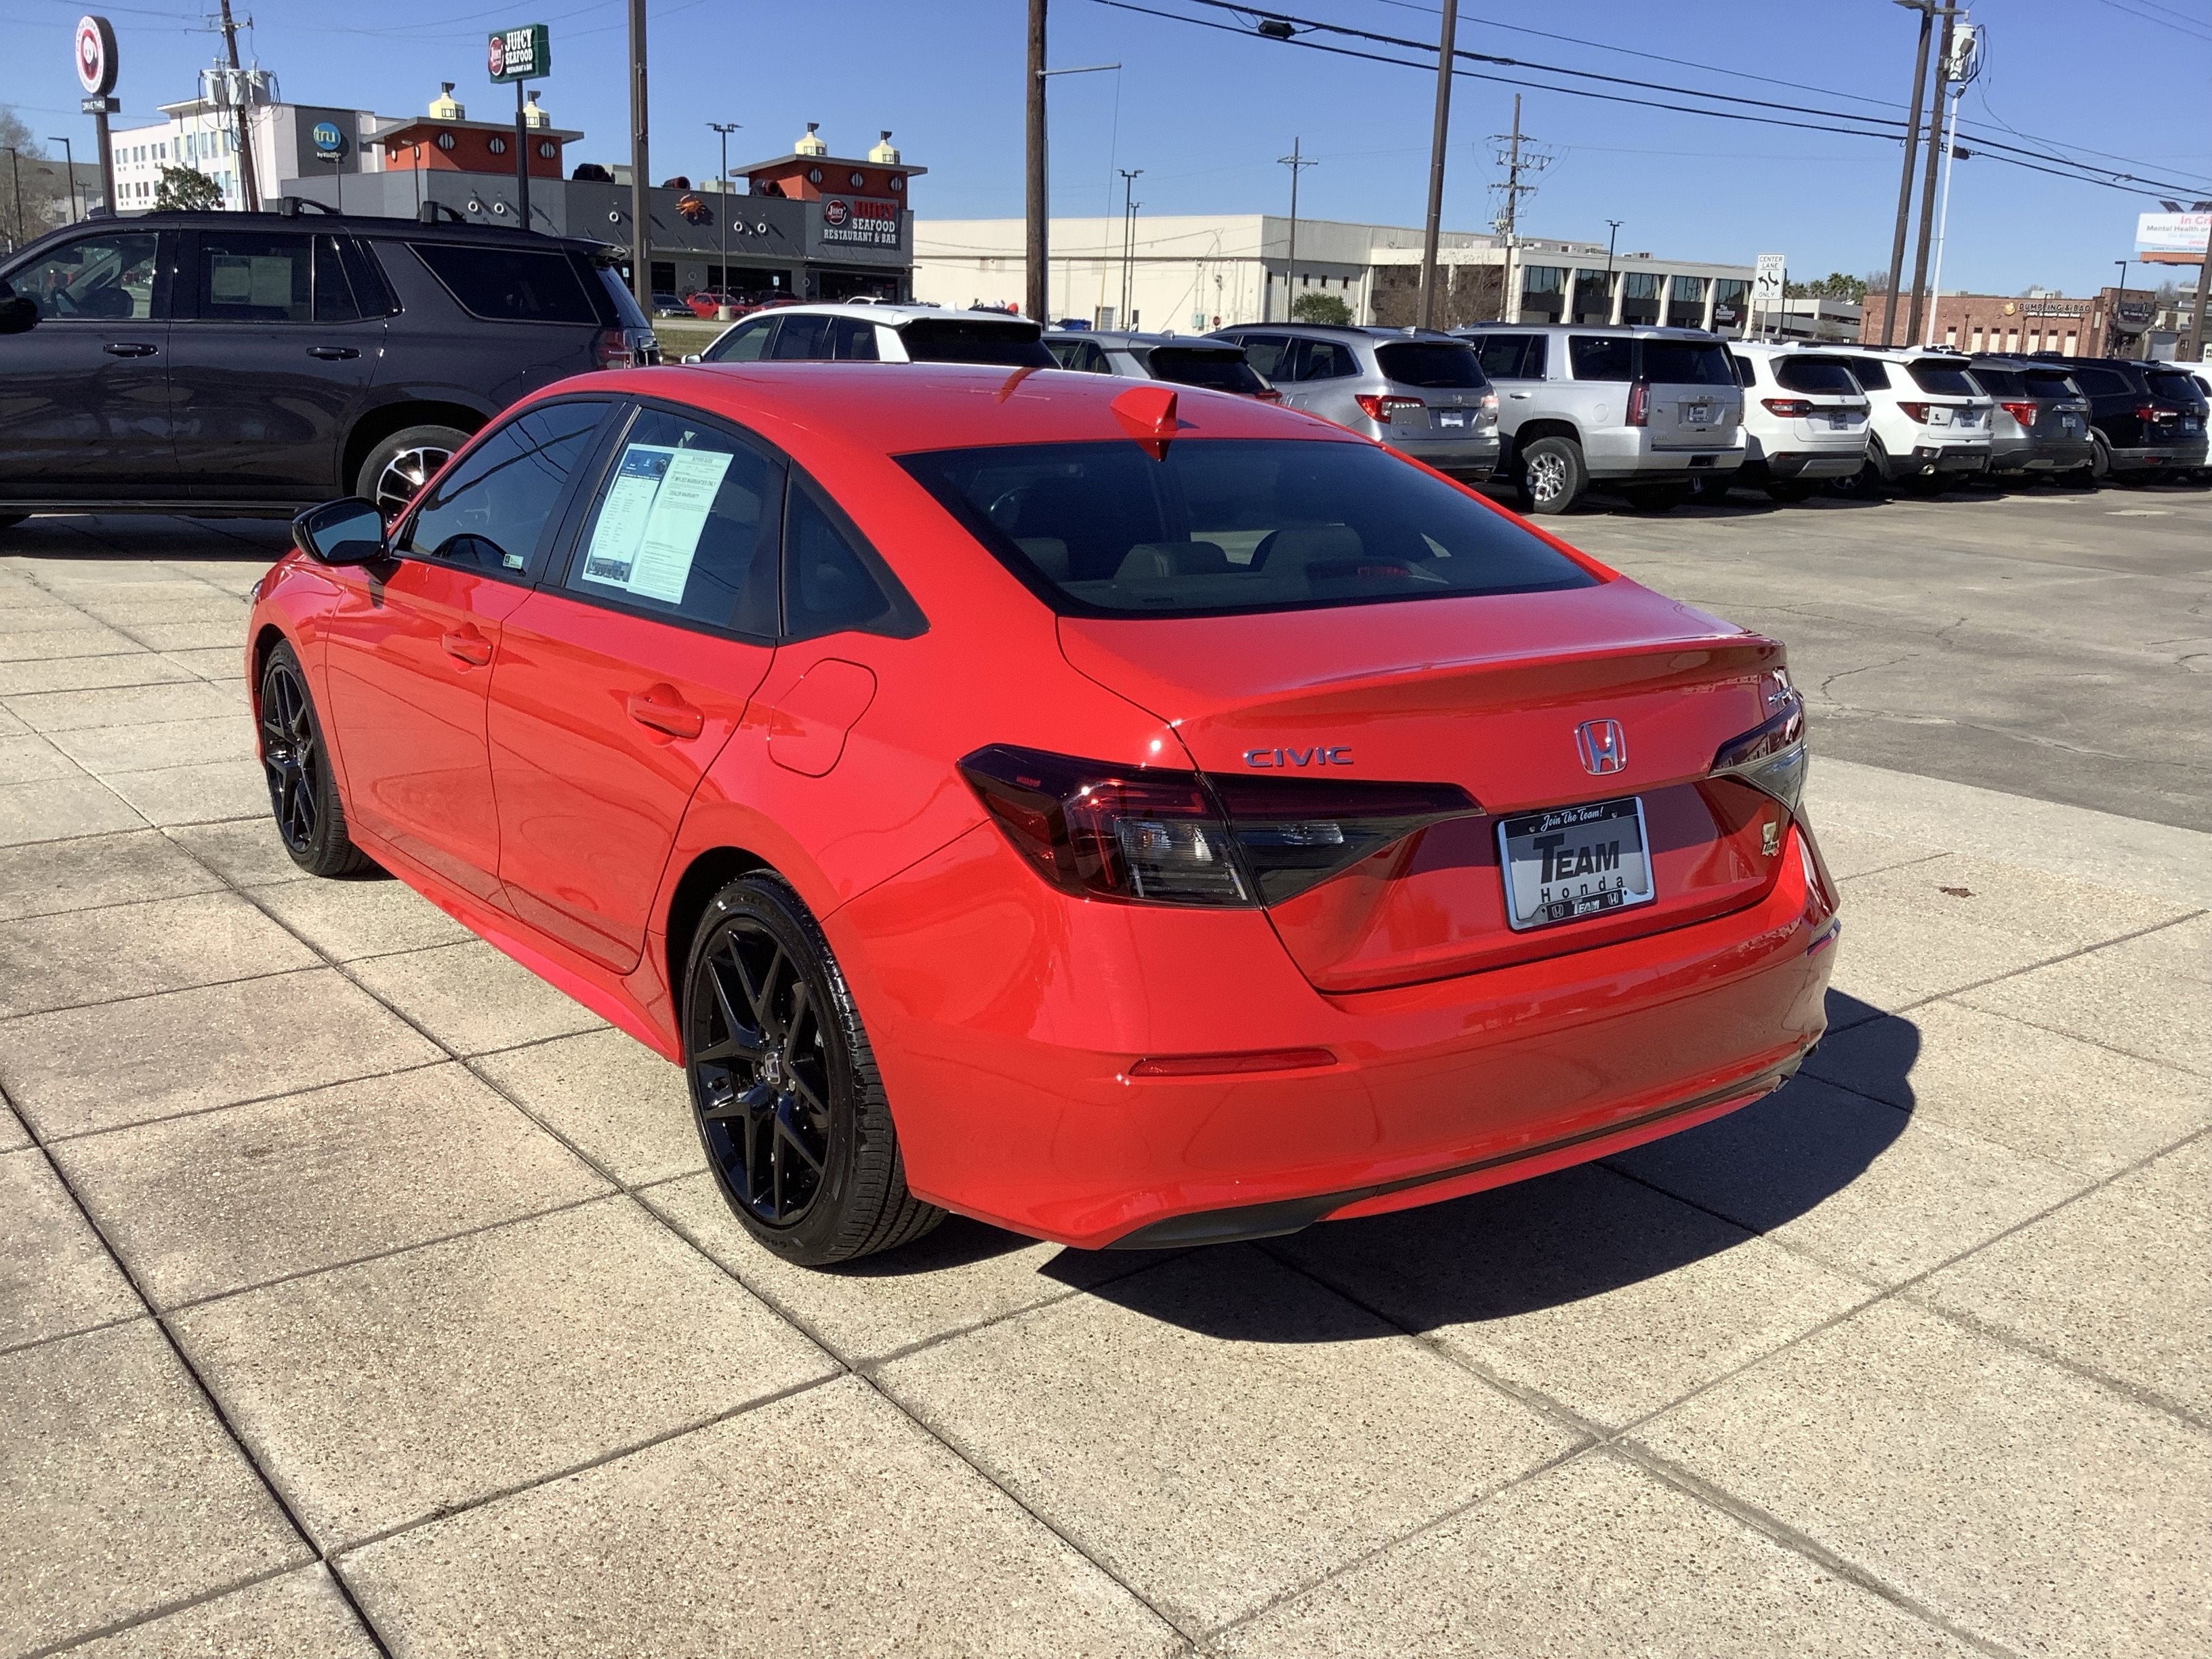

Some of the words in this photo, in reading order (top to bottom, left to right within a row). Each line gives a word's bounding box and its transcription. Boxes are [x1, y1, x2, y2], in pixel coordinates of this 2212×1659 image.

[505, 28, 533, 52] JUICY
[505, 48, 533, 65] SEAFOOD
[314, 125, 336, 143] tru
[853, 218, 895, 232] SEAFOOD
[824, 229, 873, 242] RESTAURANT
[874, 232, 880, 243] &
[881, 233, 896, 244] BAR
[2073, 305, 2091, 313] BAO
[1243, 747, 1353, 766] CIVIC
[1540, 815, 1561, 832] Join
[1563, 809, 1578, 825] The
[1579, 806, 1604, 822] Team!
[1533, 833, 1619, 885] TEAM
[1540, 876, 1626, 903] Honda
[1572, 899, 1600, 915] TEAM
